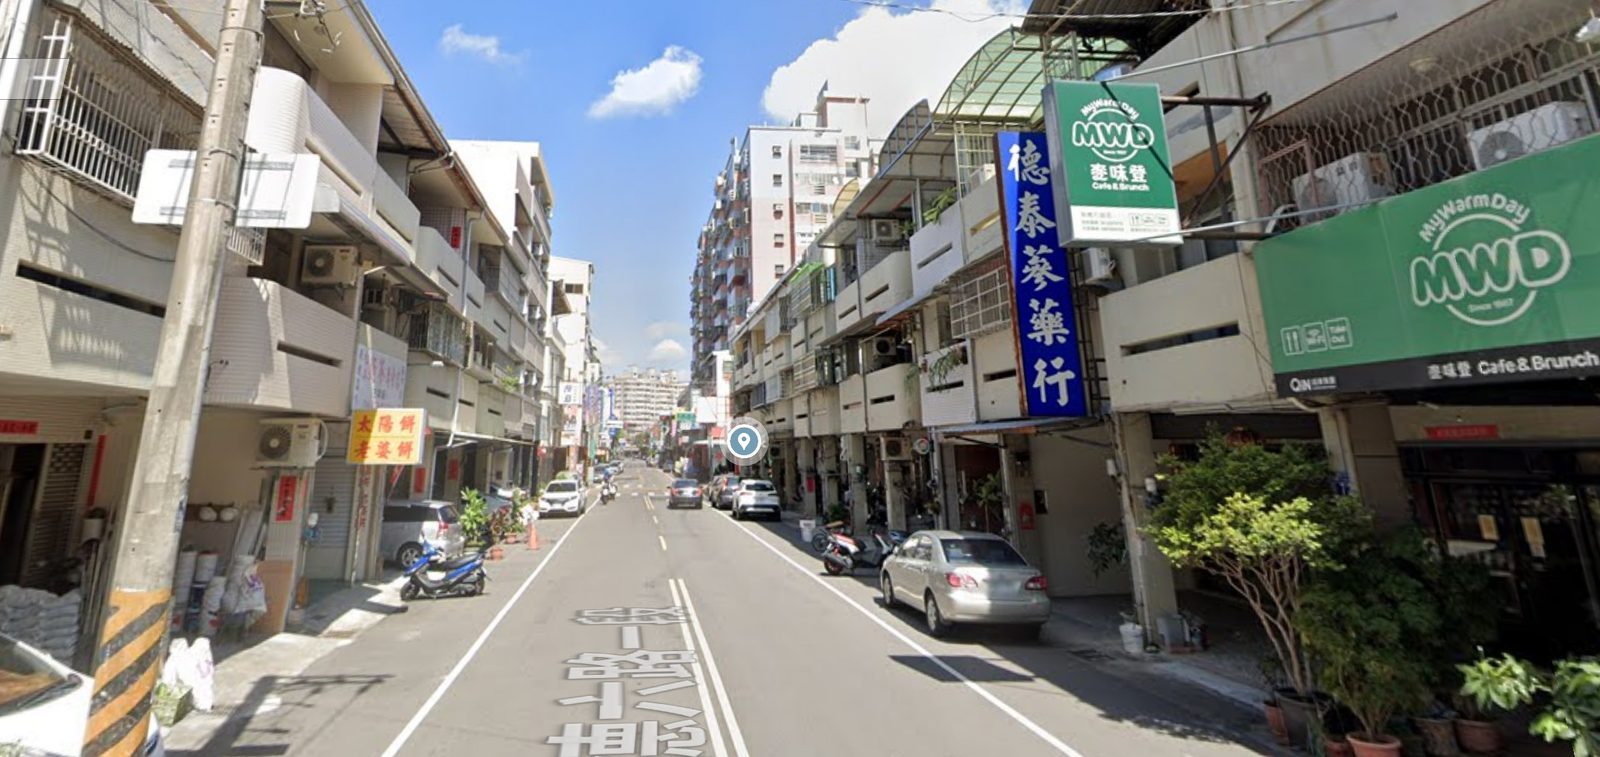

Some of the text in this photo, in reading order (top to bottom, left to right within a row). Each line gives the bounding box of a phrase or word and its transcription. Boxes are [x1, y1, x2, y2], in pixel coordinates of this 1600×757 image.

[1072, 121, 1154, 149] MWD
[1007, 139, 1076, 406] 德泰蔘藥行
[1410, 230, 1571, 306] MWD
[357, 414, 415, 433] 太陽餅
[354, 440, 412, 459] 老婆餅
